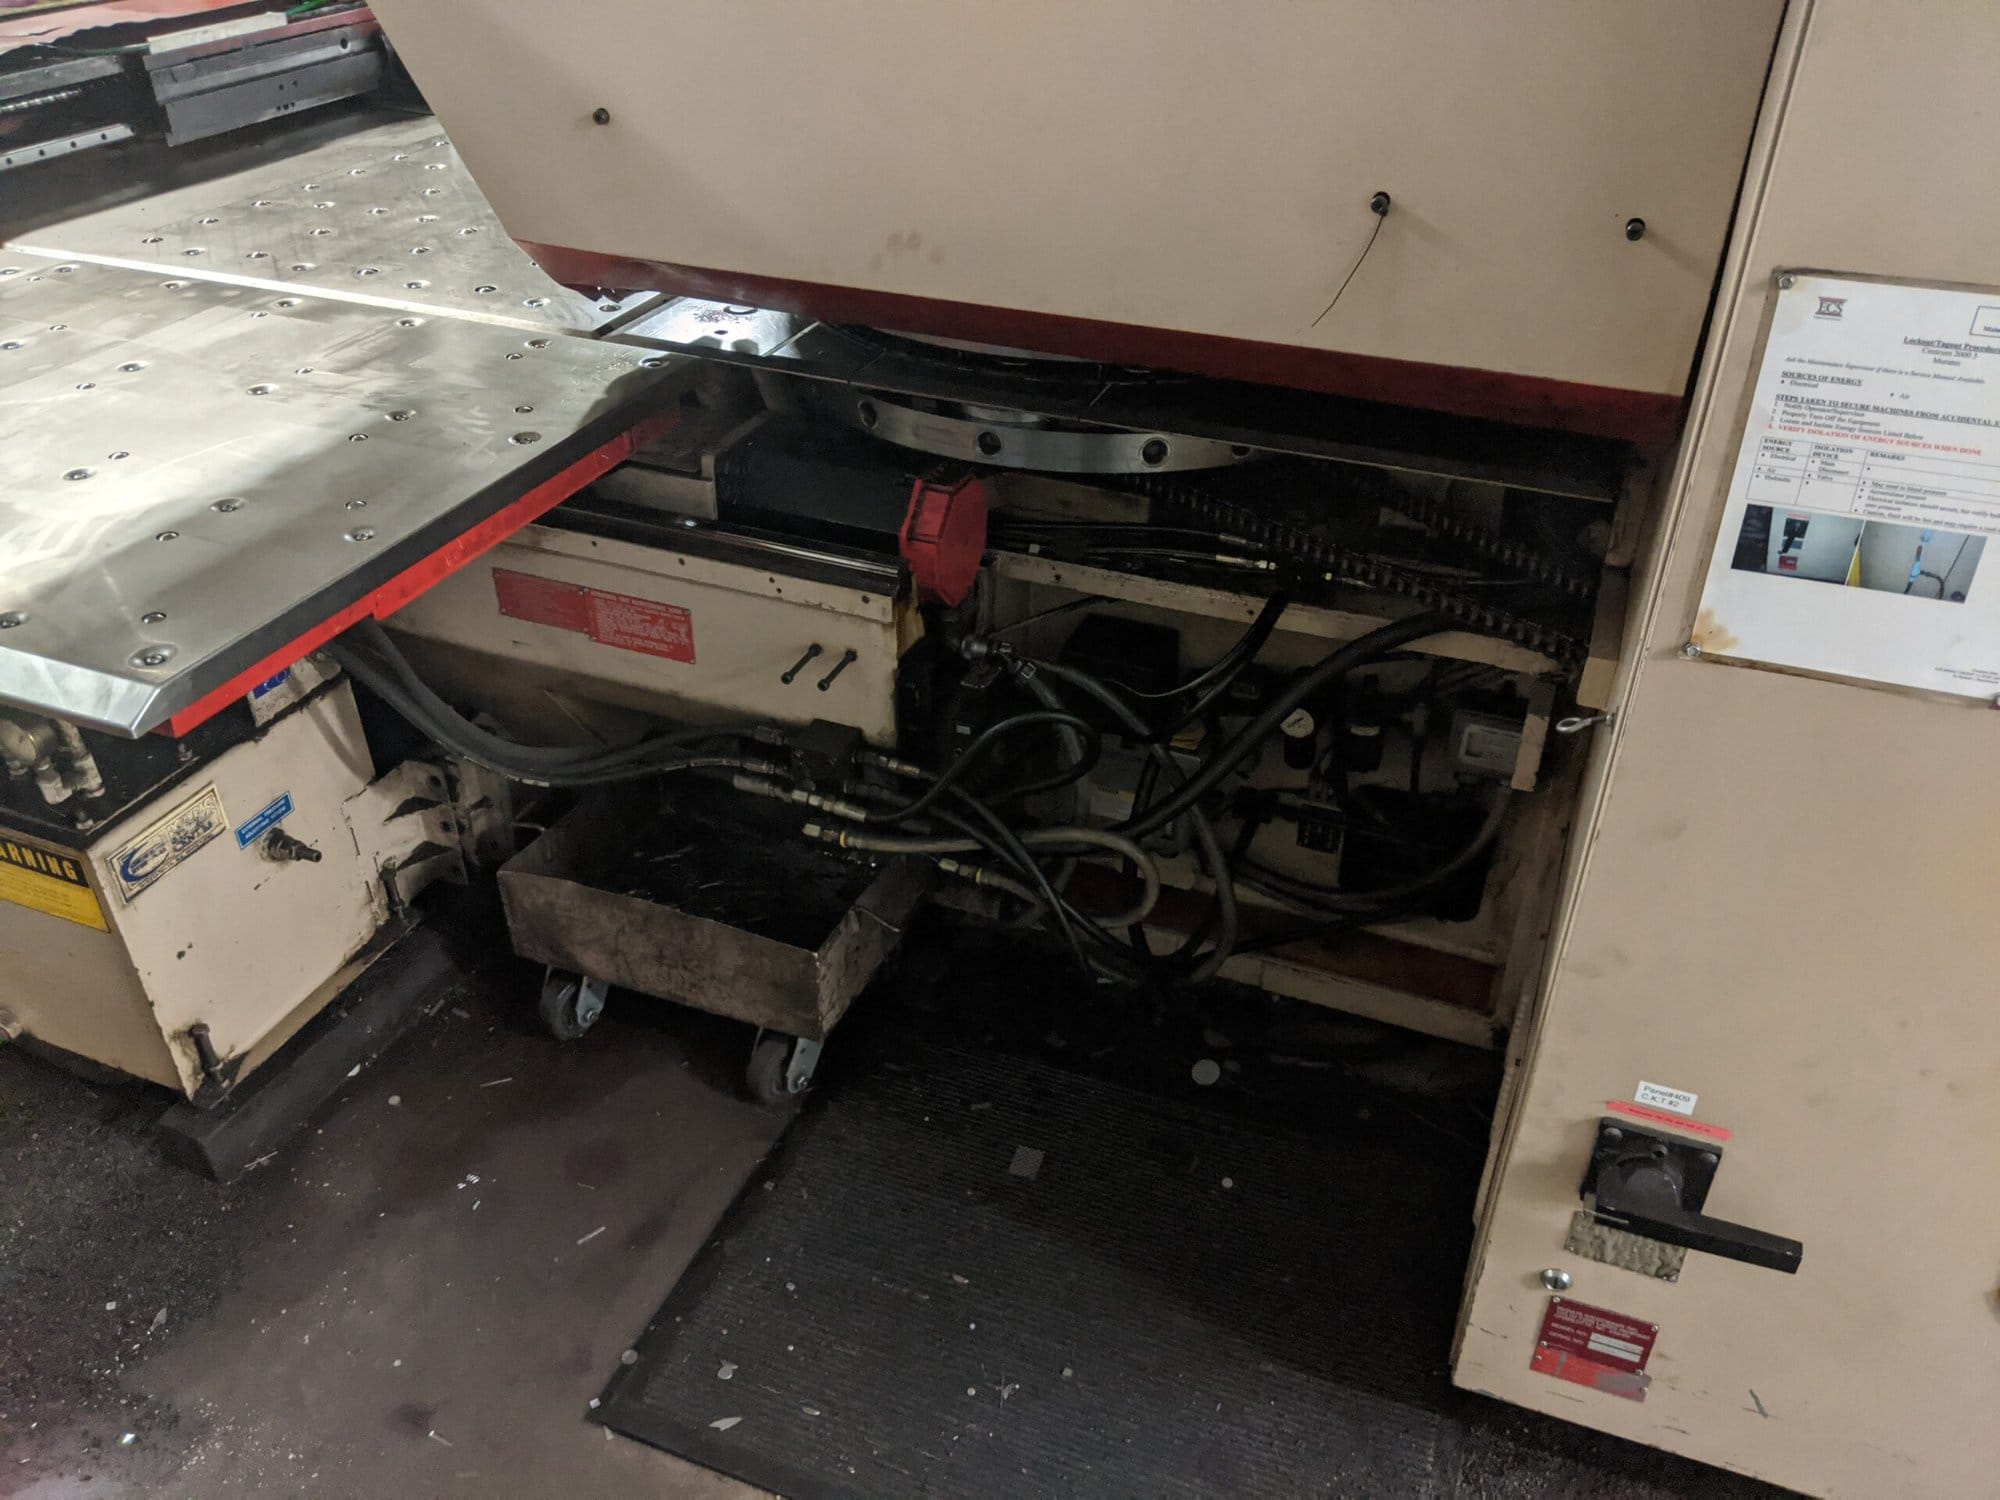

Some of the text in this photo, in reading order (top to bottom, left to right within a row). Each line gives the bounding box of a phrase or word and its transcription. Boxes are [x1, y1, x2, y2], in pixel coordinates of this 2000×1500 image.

[1819, 301, 1843, 314] ECS
[1781, 371, 1818, 381] SOURCES
[1831, 376, 1863, 386] ENERGY
[1776, 394, 1799, 403] STEPS
[1800, 396, 1826, 406] TAKEN
[1828, 399, 1839, 407] TO
[1840, 401, 1870, 411] SECURE
[1872, 405, 1914, 418] MACHINES
[1915, 411, 1939, 420] FROM
[1941, 414, 1993, 426] ACCIDENTAL
[1764, 438, 1792, 447] ENERGY
[1779, 425, 1805, 433] VERIFY
[1807, 428, 1849, 438] ISOLATION
[1862, 434, 1894, 444] ENERGY
[1896, 440, 1932, 449] SOURCES
[1959, 448, 1982, 456] DONE
[1763, 445, 1790, 453] SOURCE
[1815, 445, 1853, 454] ISOLATION
[1813, 451, 1839, 459] DEVICE
[1870, 451, 1905, 461] REMARKS
